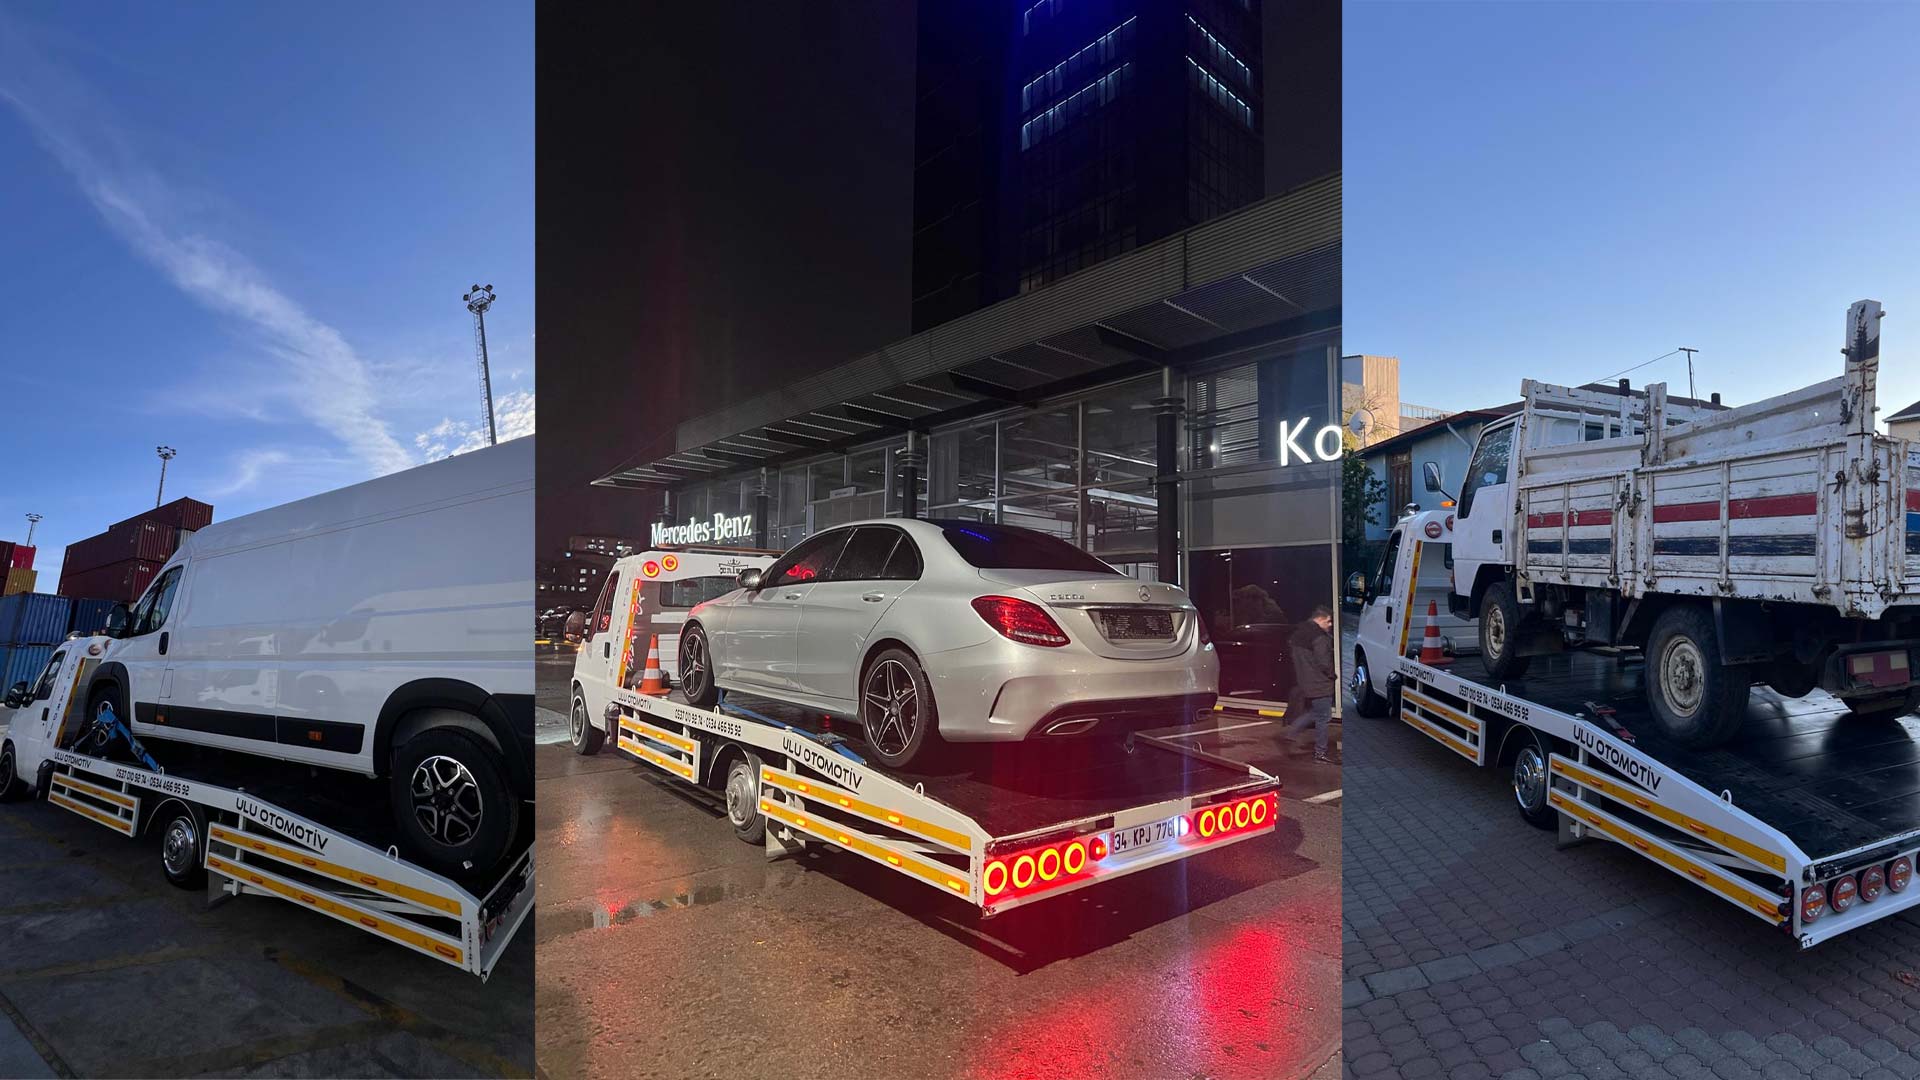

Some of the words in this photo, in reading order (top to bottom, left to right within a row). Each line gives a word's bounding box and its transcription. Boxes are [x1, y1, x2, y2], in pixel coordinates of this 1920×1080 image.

[1280, 416, 1342, 467] Ko
[651, 512, 752, 548] Mercedes-Benz
[783, 736, 801, 757] ULU
[803, 748, 863, 789] OTOMOTİV
[1573, 724, 1594, 749] ULU
[1596, 739, 1662, 790] OTOMOTİV
[236, 797, 258, 817] ULU
[259, 808, 329, 850] OTOMOTİV
[1114, 832, 1127, 851] 34
[1133, 826, 1151, 847] KPJ
